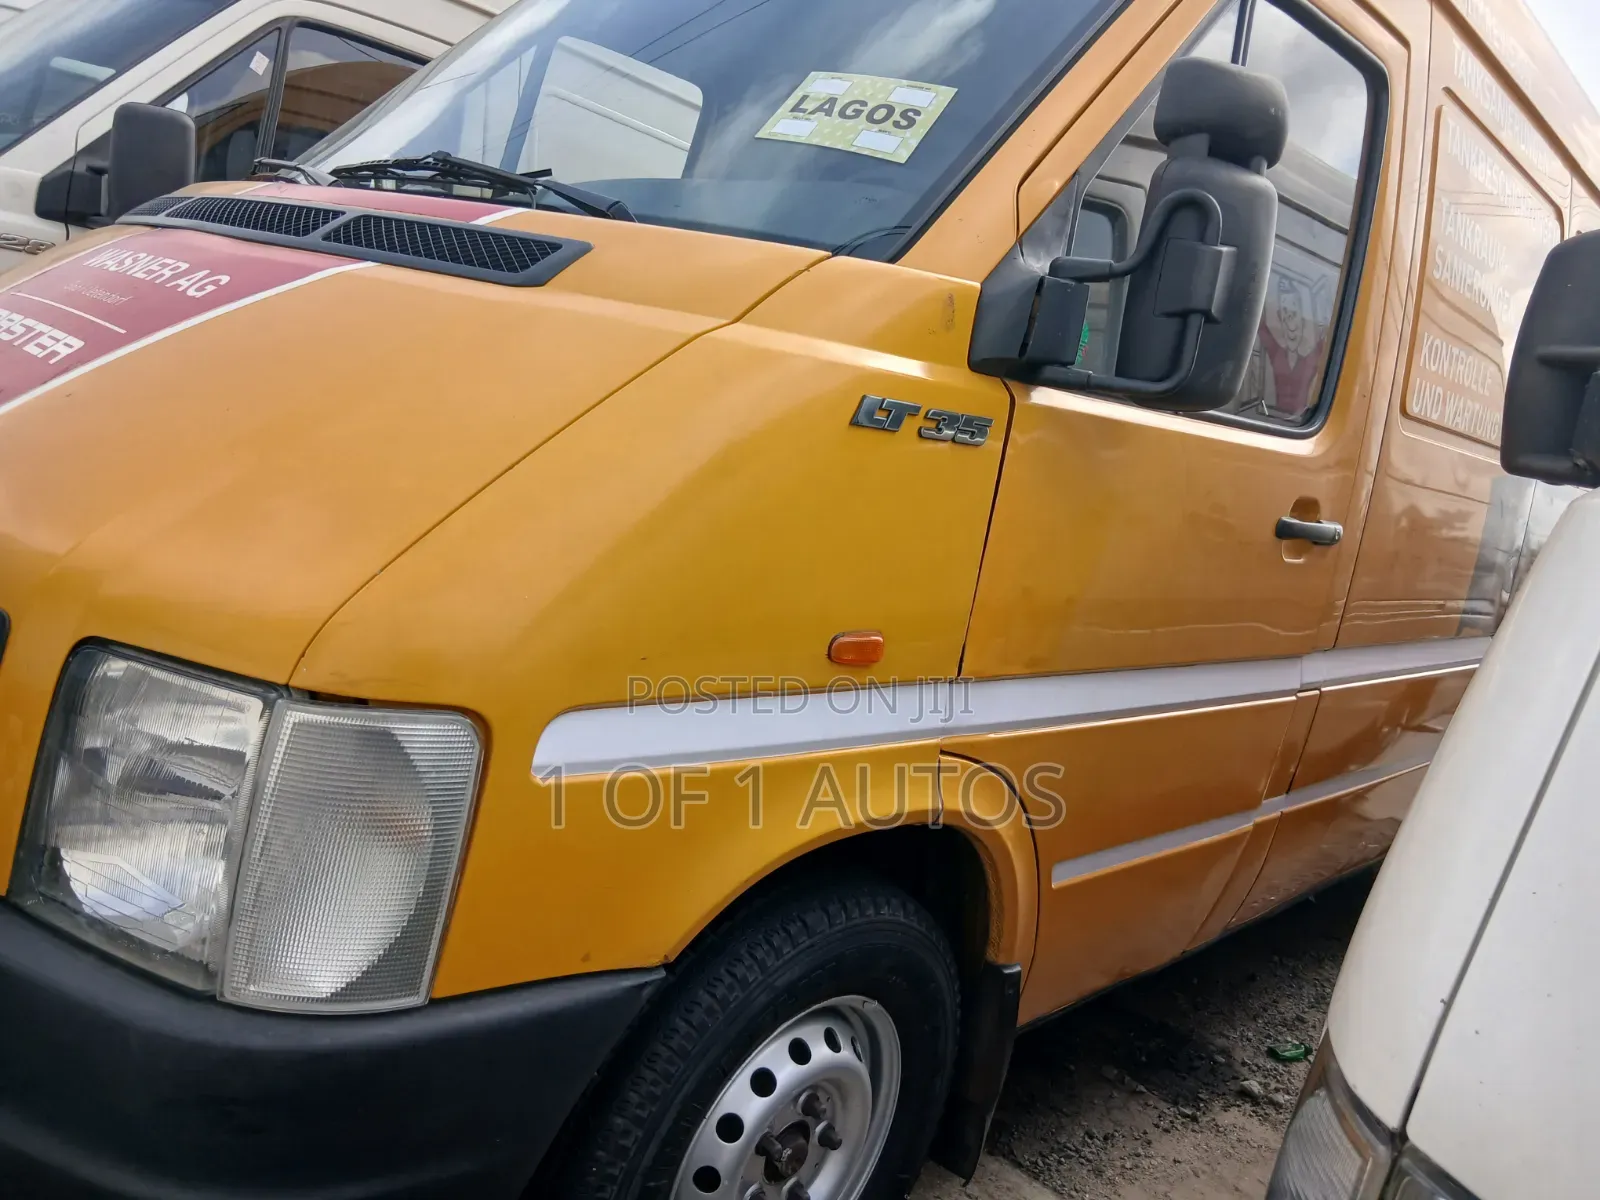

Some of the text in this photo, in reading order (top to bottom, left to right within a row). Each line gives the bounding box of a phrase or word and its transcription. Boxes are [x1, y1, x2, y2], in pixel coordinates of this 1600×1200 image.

[788, 94, 922, 131] LAGOS
[82, 248, 231, 299] WASNER AG
[1420, 332, 1492, 396] KONTROLLE
[849, 394, 995, 446] LT 35
[1412, 378, 1500, 440] UND WARTUNG
